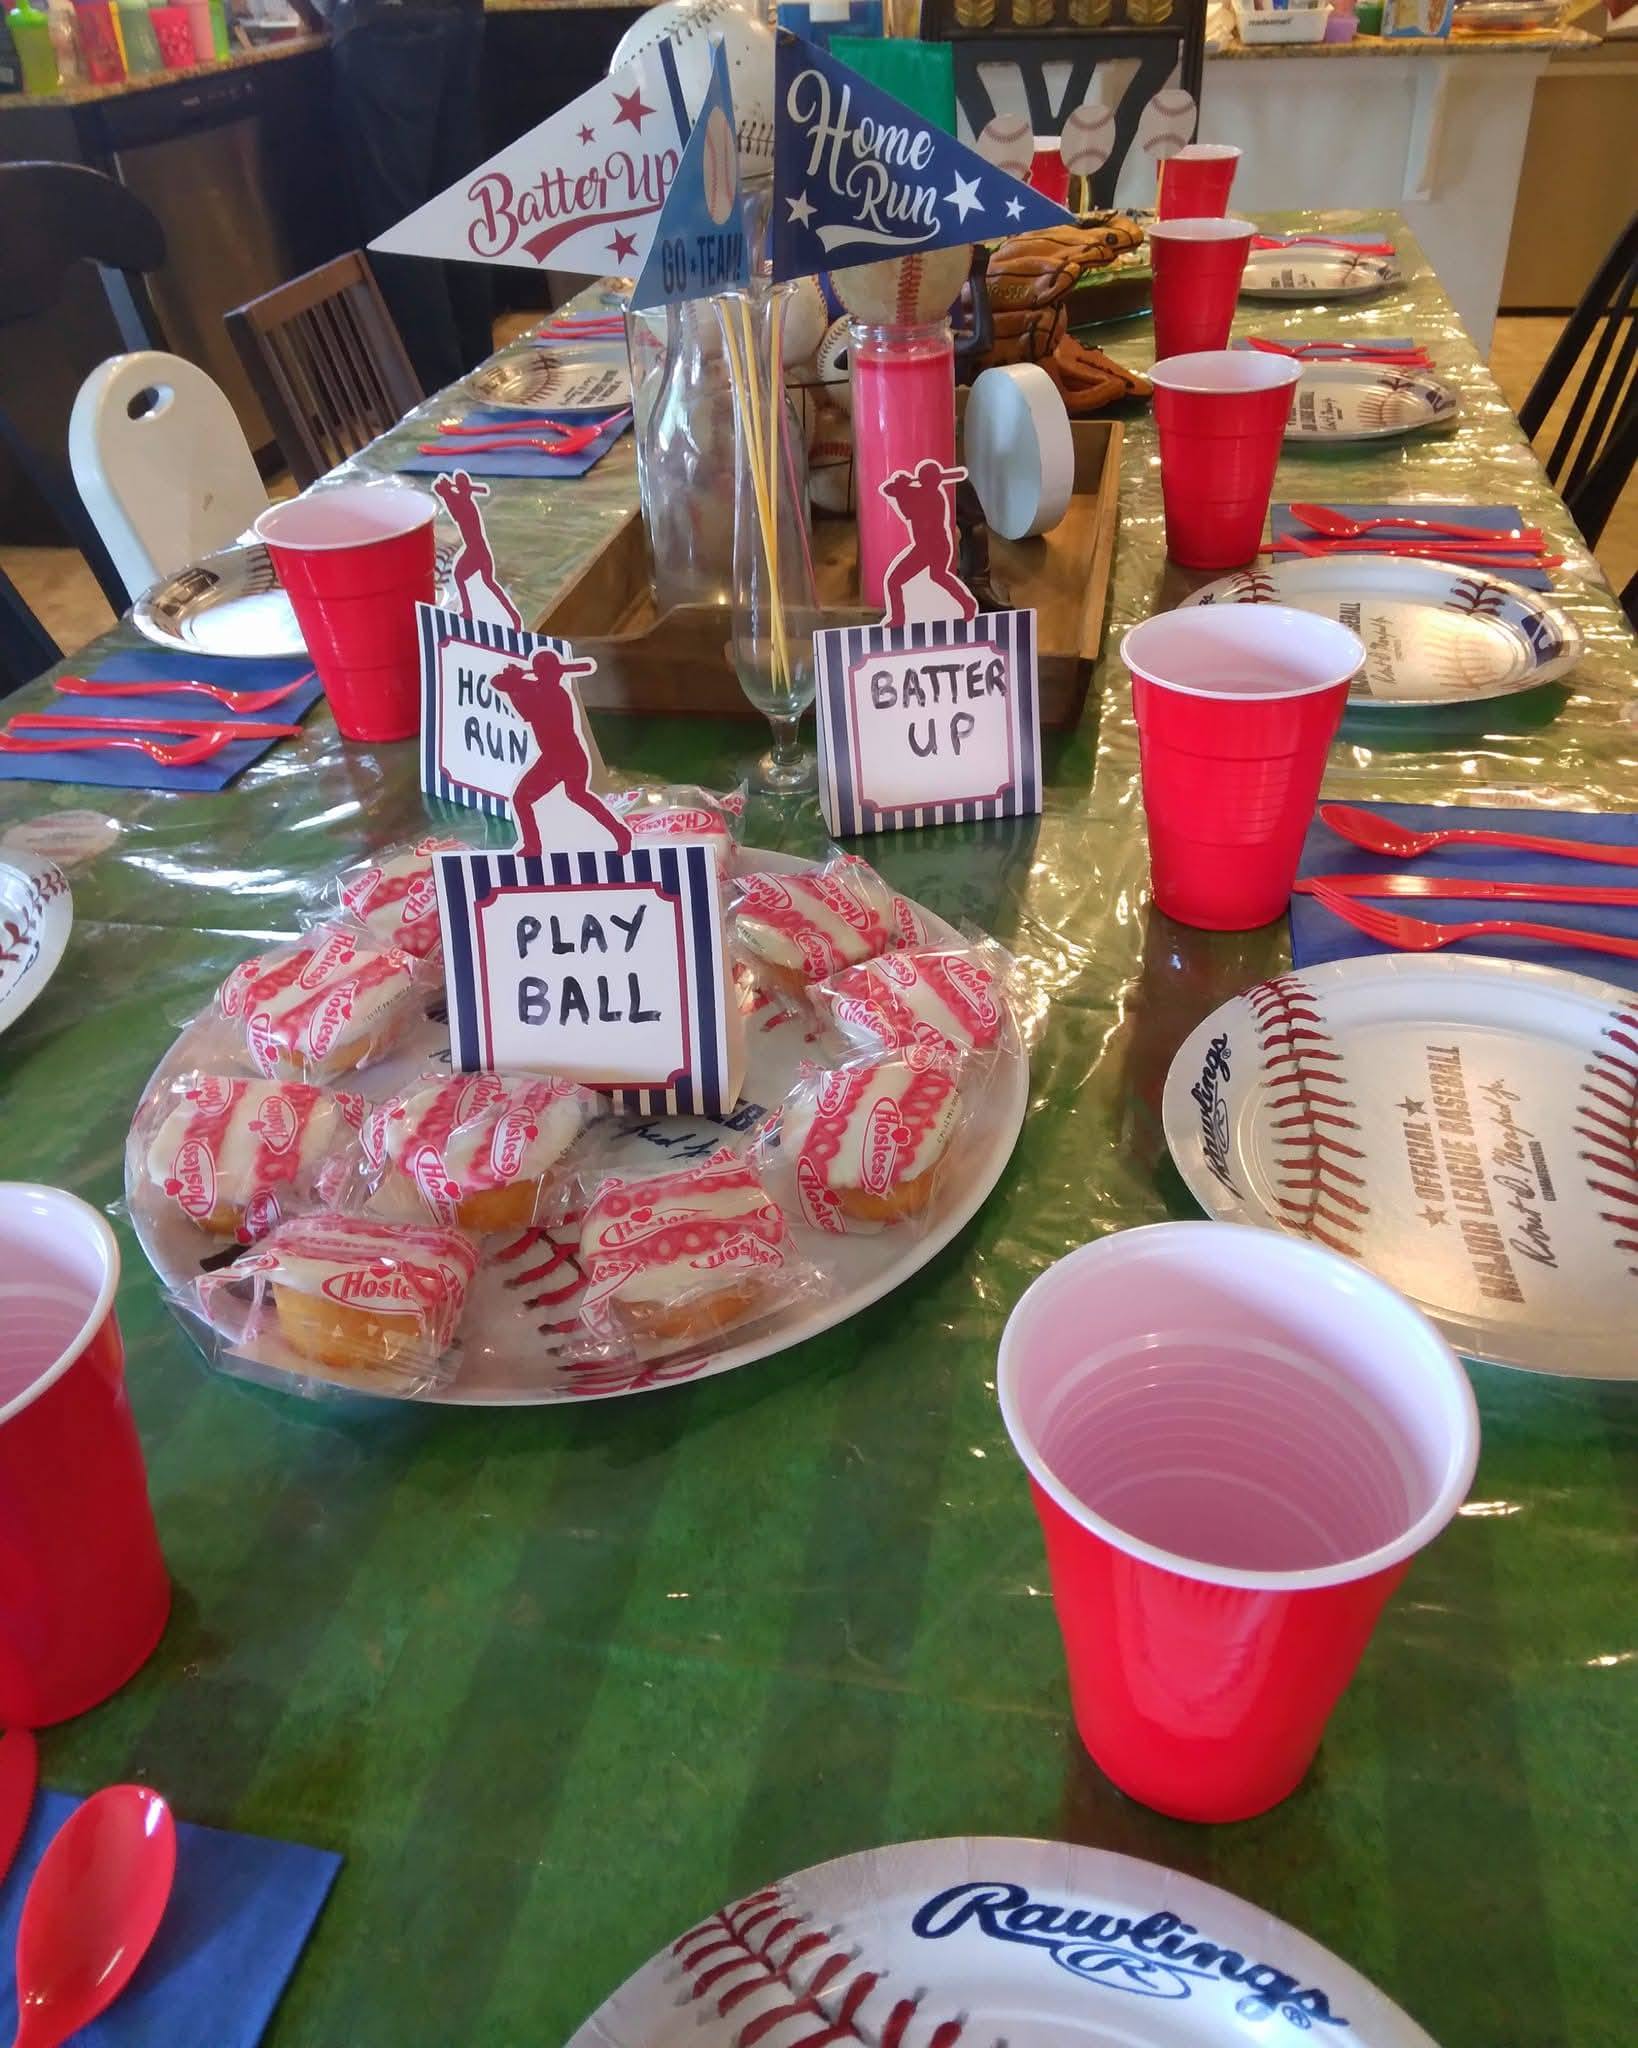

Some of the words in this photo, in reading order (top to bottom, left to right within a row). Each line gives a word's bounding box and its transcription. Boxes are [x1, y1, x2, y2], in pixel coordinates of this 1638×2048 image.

[787, 69, 935, 196] Home
[468, 167, 608, 258] Batter
[605, 149, 680, 207] Up
[846, 160, 941, 233] Run
[661, 238, 687, 294] GO
[871, 658, 1007, 709] BATTER
[464, 715, 529, 766] RUN
[908, 711, 975, 758] UP
[303, 933, 356, 987] Hostess
[516, 904, 648, 960] PLAY
[518, 972, 662, 1026] BALL
[1427, 1046, 1475, 1139] BASEBALL
[502, 1112, 535, 1172] Hostess
[872, 1108, 901, 1187] Hostess
[1404, 1122, 1445, 1202] OFFICIAL
[1441, 1137, 1495, 1217] LEAGUE
[1461, 1218, 1525, 1303] MAJOR
[911, 1881, 1350, 2027] Rawlings
